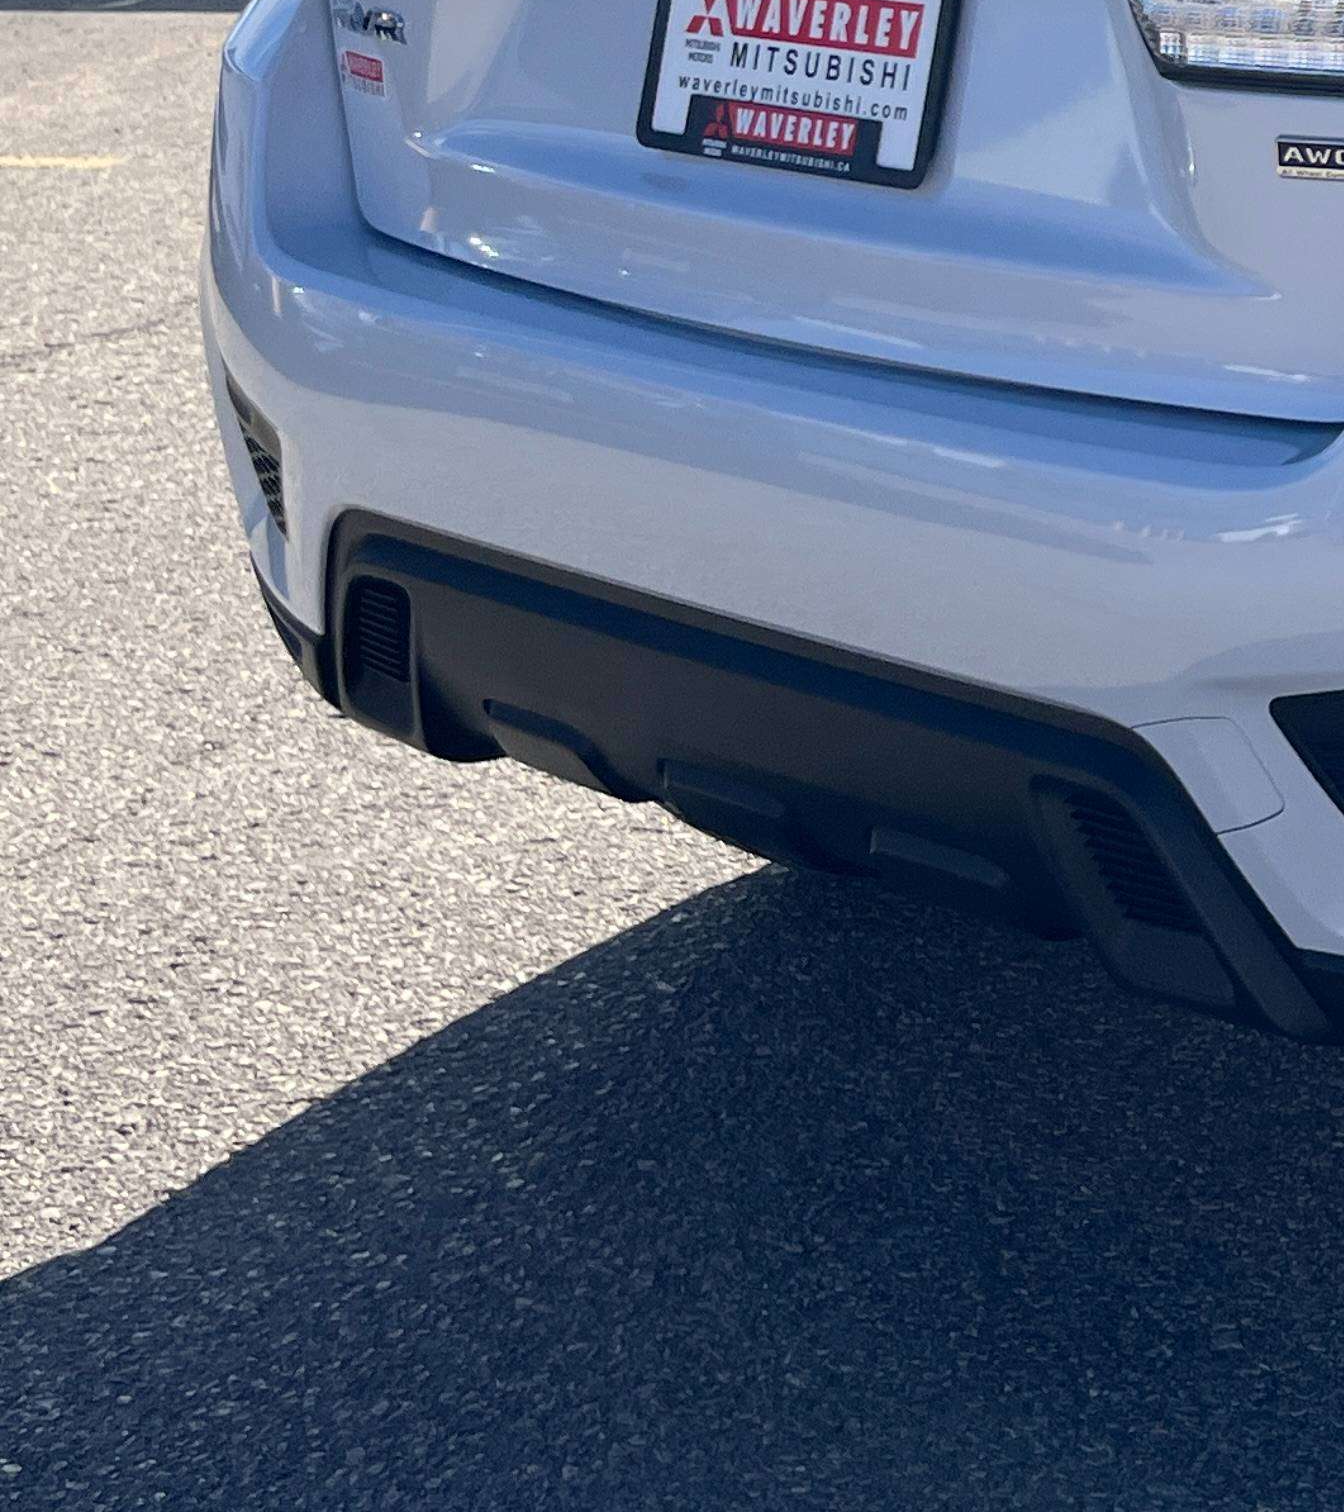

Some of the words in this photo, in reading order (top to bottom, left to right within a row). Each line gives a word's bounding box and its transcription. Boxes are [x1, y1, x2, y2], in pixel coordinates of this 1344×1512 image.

[729, 41, 912, 91] MITSUBISHI
[678, 74, 908, 121] waverleymitsubishi.com
[735, 107, 856, 150] WAVERLEY
